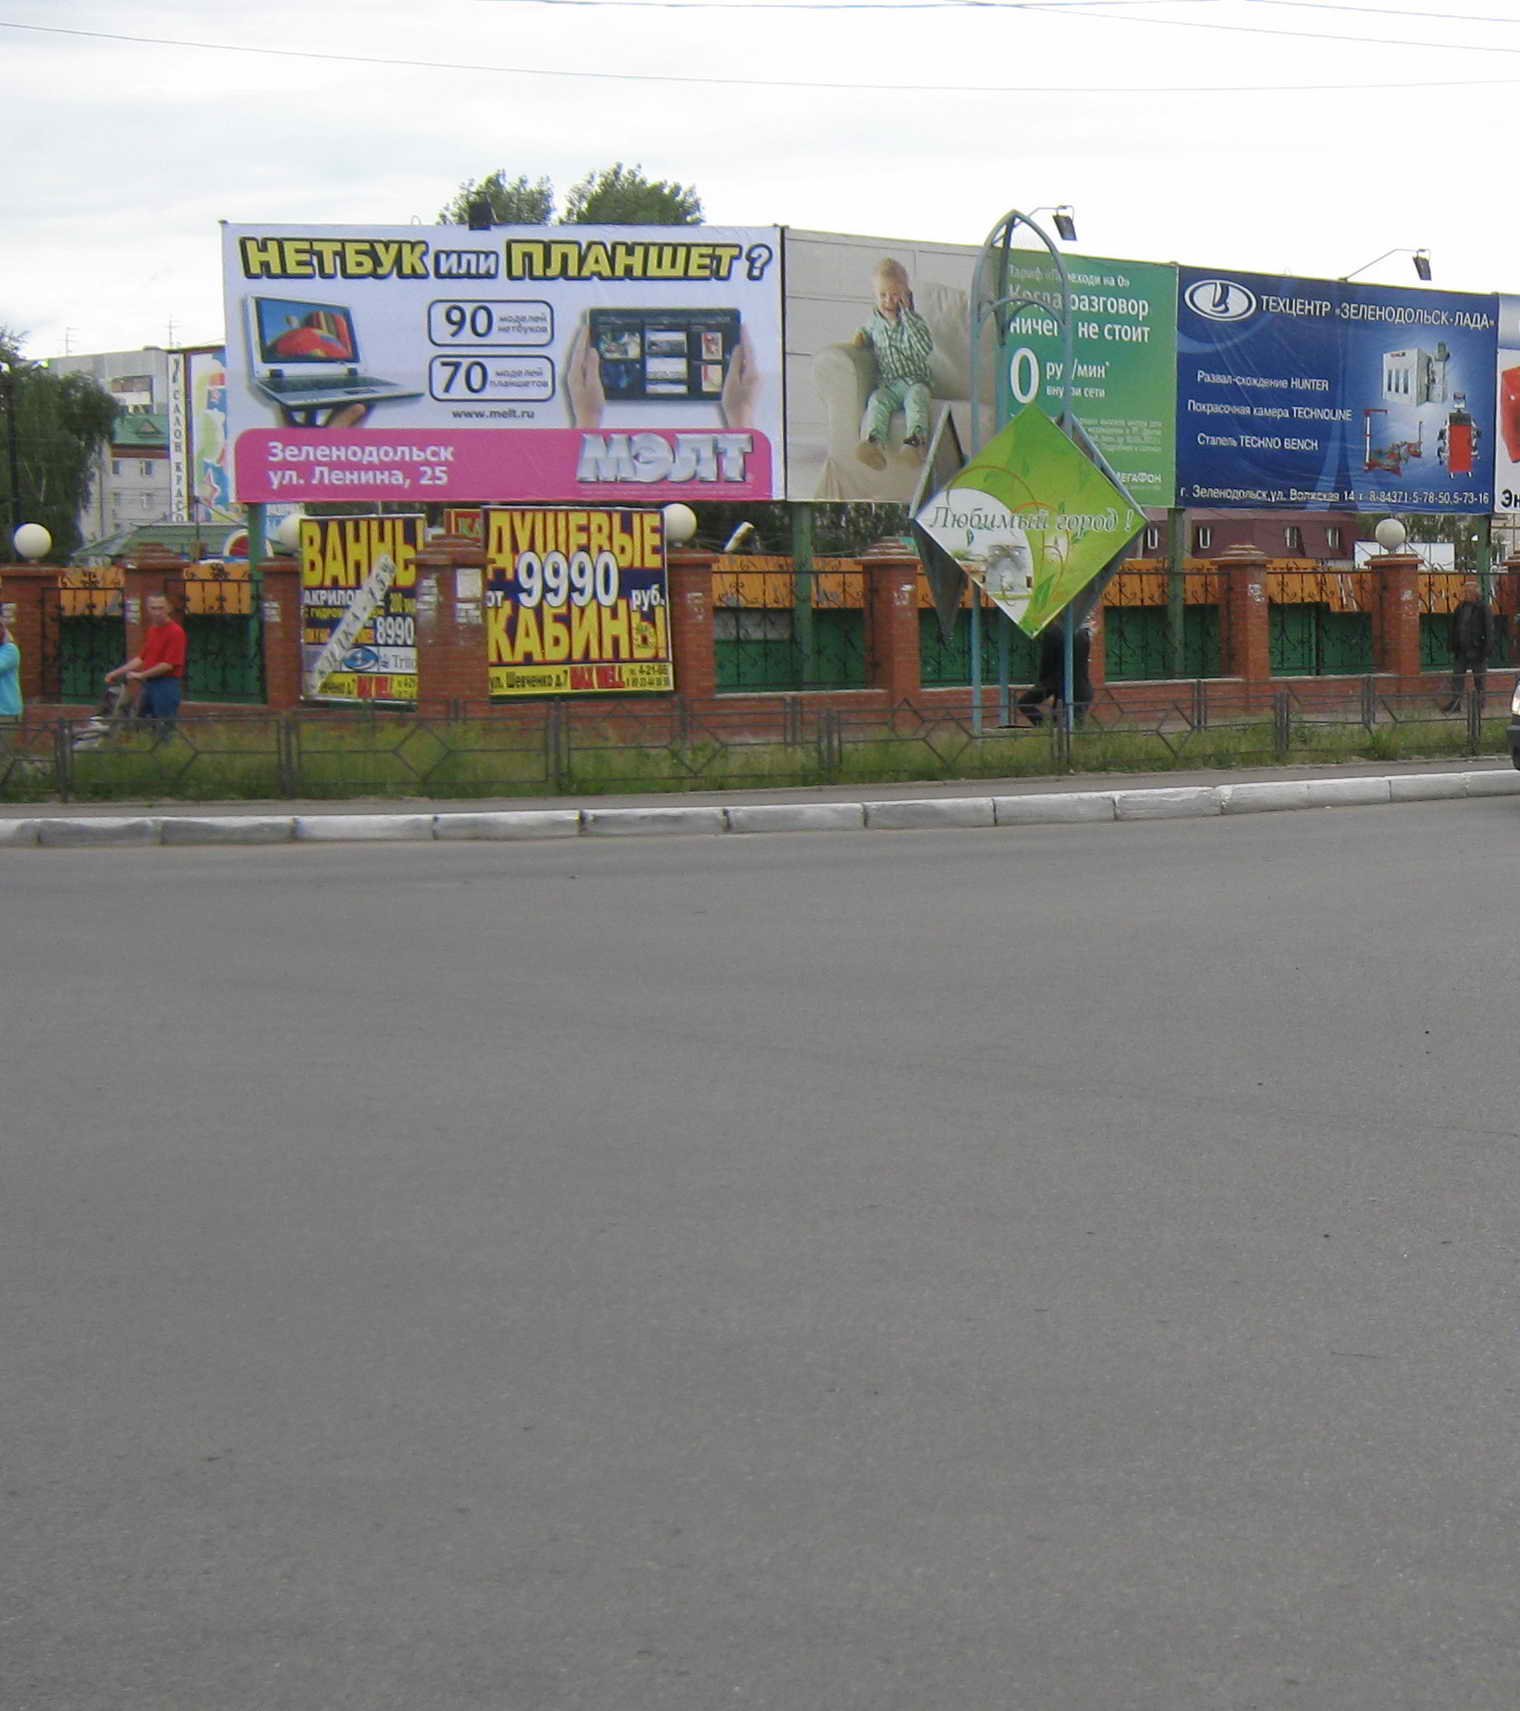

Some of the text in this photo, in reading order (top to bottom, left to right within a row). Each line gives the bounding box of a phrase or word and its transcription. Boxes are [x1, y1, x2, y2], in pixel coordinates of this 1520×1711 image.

[241, 238, 429, 279] НЕТБУК
[499, 312, 547, 324] моделей
[1261, 295, 1331, 317] ТЕХЦЕНТР
[445, 304, 493, 338] 90
[497, 323, 548, 335] нетбуков
[1079, 322, 1099, 340] не
[1104, 324, 1150, 344] стоит
[440, 360, 488, 394] 70
[489, 379, 549, 389] планшетов
[495, 367, 543, 378] моделей
[1010, 347, 1040, 404] 0
[1197, 370, 1329, 391] Развал-схождение HUNTER
[1084, 387, 1105, 399] сети
[451, 408, 535, 420] www.melt.ru
[1187, 399, 1352, 422] Покрасочная камера TECHNOLINE
[268, 441, 454, 464] Зеленодольск
[1240, 435, 1281, 449] TECHNO
[1284, 437, 1318, 451] BENCH
[576, 432, 753, 484] МЭЛТ
[268, 465, 448, 491] ул. Ленина, 25
[929, 505, 1048, 531] Любимый
[1056, 510, 1119, 538] город
[302, 517, 424, 588] ВАННЫ
[487, 510, 664, 580] ДУШЕВЫЕ
[517, 550, 619, 609] 9990
[486, 584, 665, 612] от руб.
[376, 616, 415, 643] 8990
[489, 597, 667, 663] КАБИНЫ
